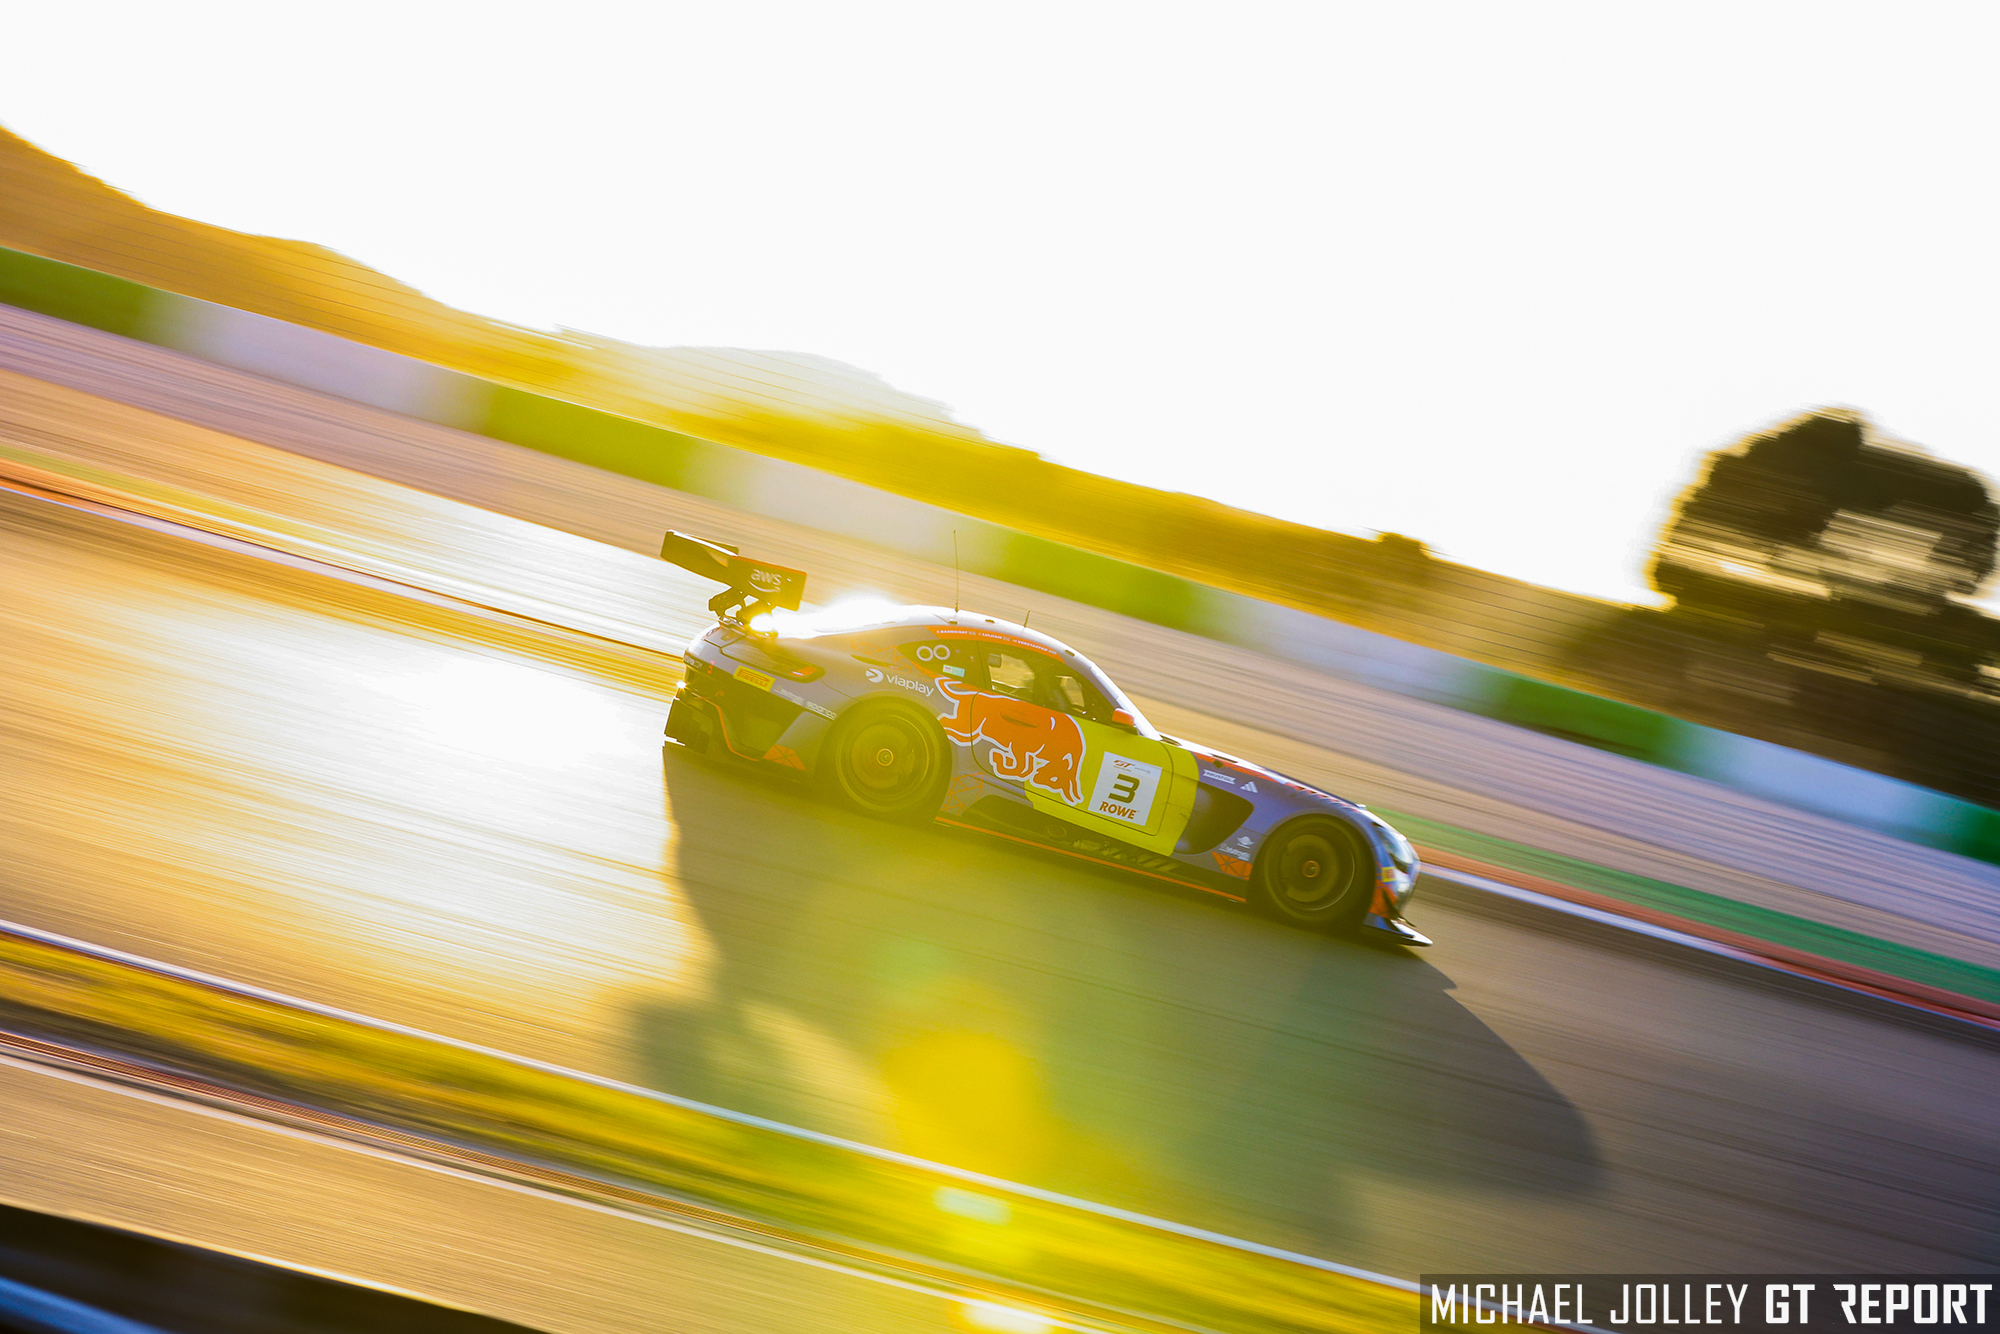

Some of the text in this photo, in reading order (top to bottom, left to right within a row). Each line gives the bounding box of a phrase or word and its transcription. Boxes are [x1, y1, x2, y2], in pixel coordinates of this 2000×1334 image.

[750, 568, 782, 586] aws
[885, 674, 935, 697] viaplay
[1107, 773, 1141, 804] 3
[1099, 801, 1137, 820] ROWE
